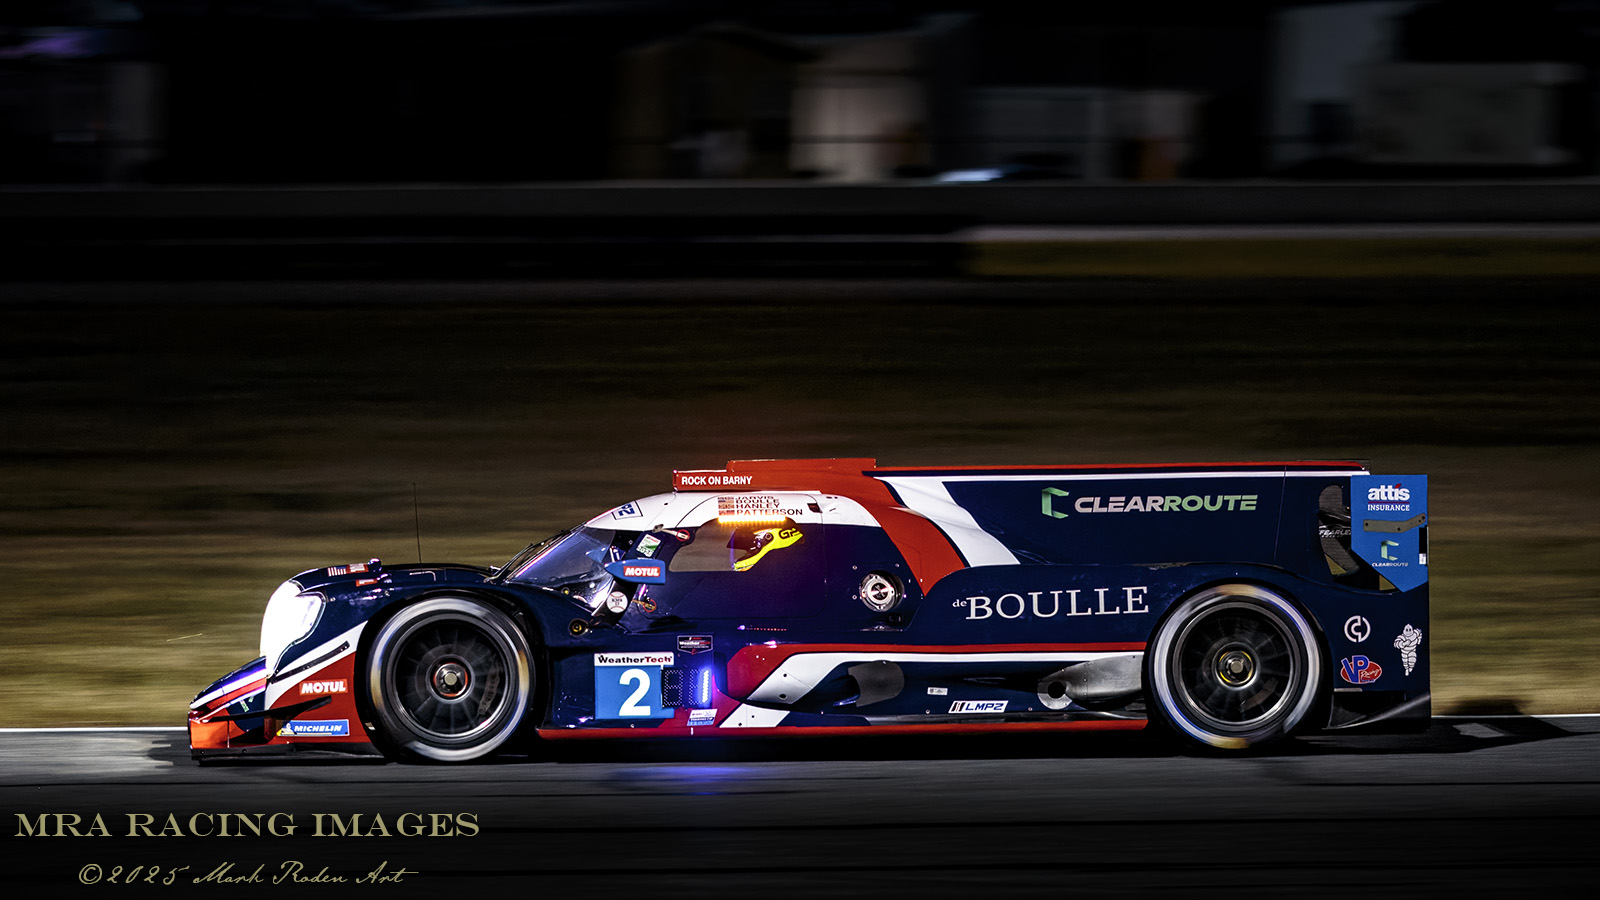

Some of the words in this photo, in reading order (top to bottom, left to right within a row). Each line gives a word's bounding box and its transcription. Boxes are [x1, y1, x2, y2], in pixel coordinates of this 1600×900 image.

[681, 476, 707, 485] ROCK
[708, 476, 722, 485] ON
[722, 476, 753, 485] BARNY
[1367, 483, 1410, 501] attis
[1074, 494, 1258, 513] CLEARROUTE
[1367, 504, 1410, 512] INSURANCE
[624, 567, 660, 577] MOTUL
[1341, 655, 1370, 683] VP
[301, 681, 346, 694] MOTUL
[618, 668, 651, 716] 2
[965, 702, 1005, 712] LMP2
